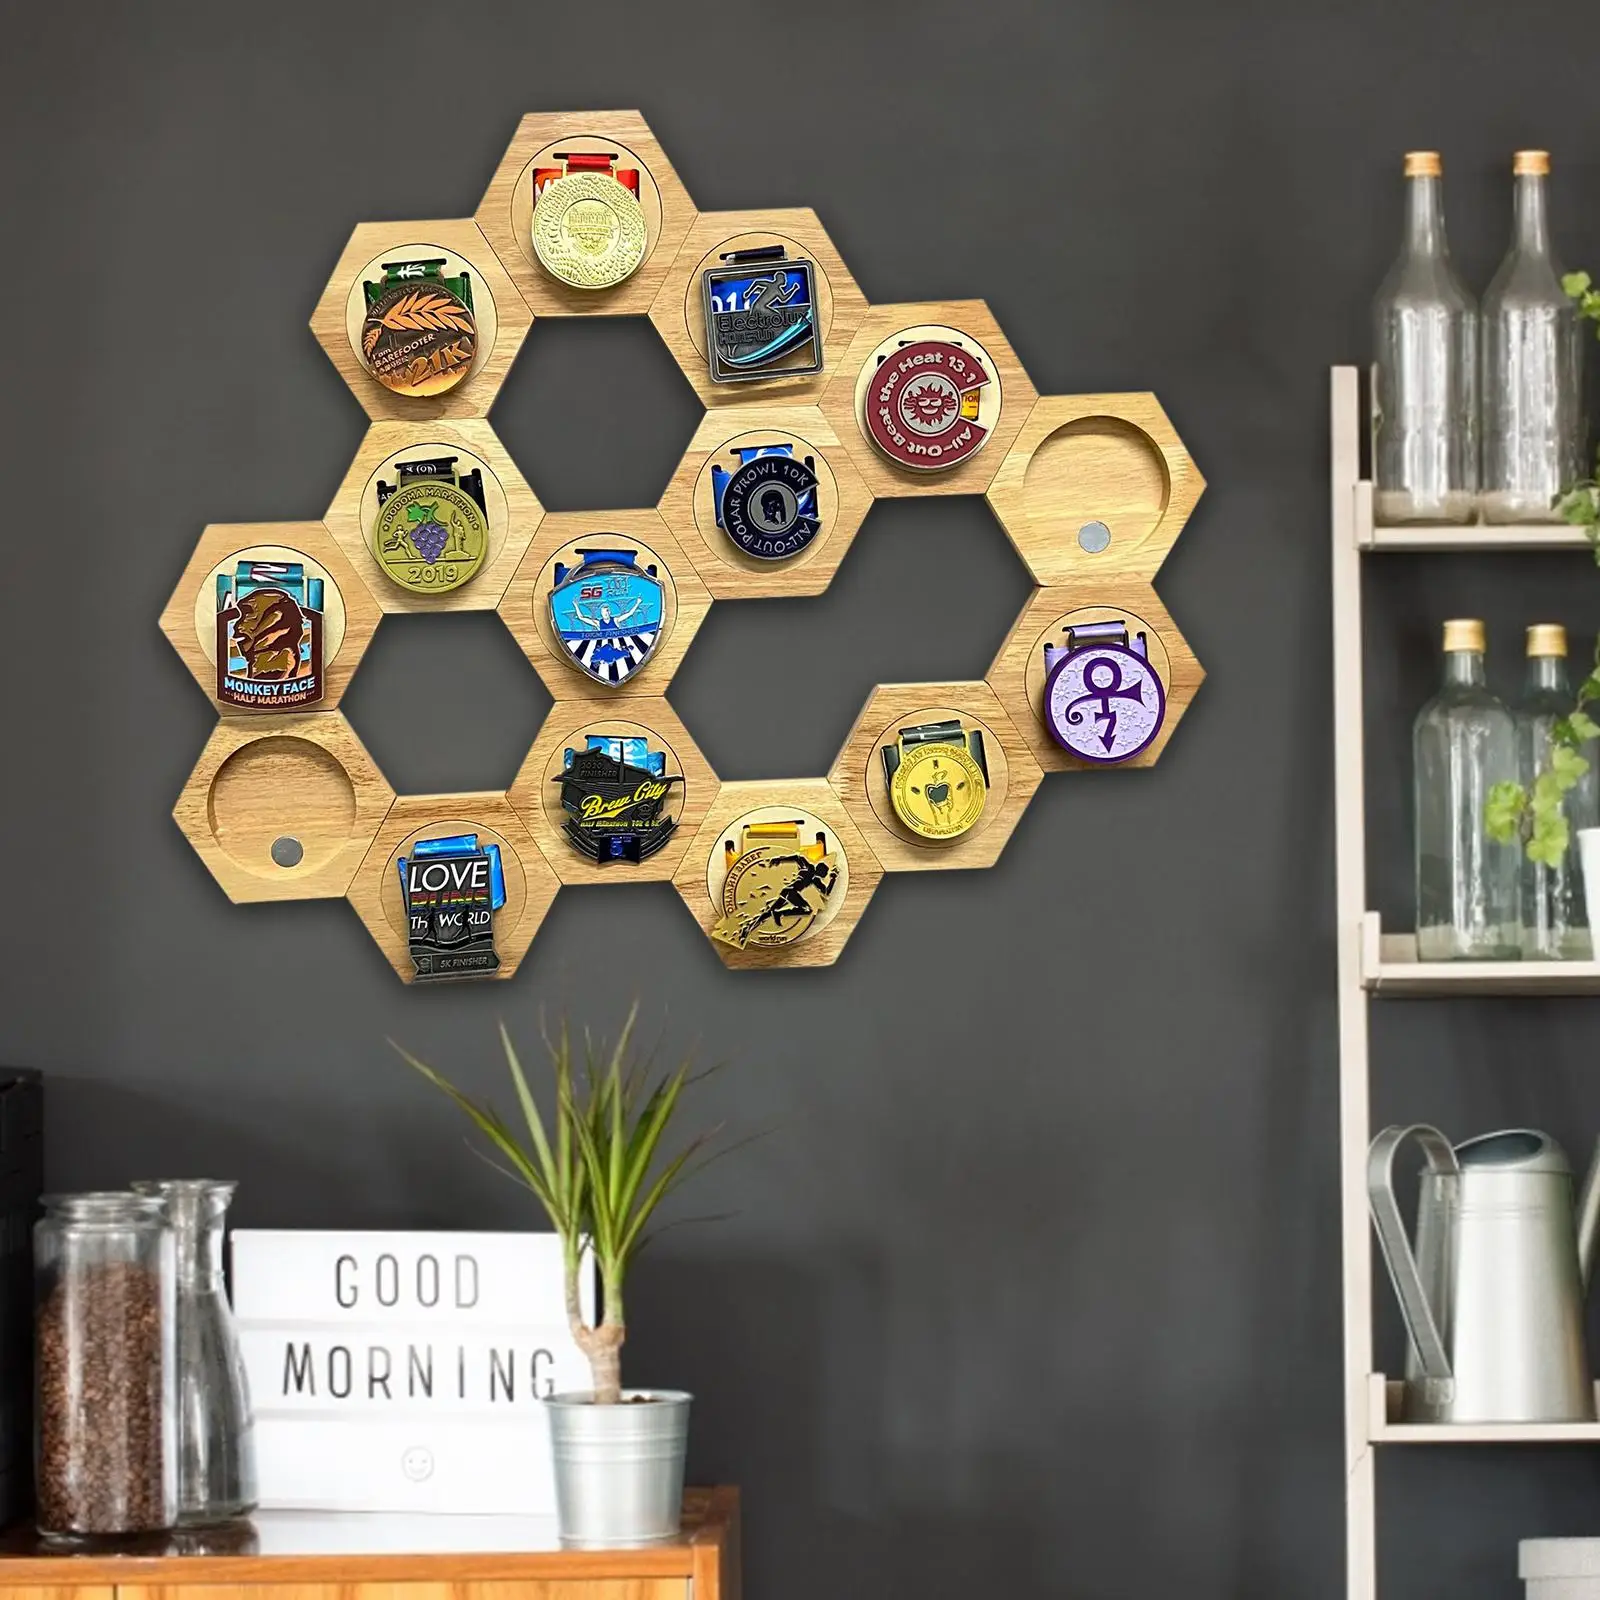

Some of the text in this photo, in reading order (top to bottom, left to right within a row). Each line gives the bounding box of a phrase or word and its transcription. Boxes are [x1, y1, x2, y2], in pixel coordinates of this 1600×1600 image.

[718, 310, 812, 332] Electrolux
[375, 333, 436, 368] BAREFOOTER
[408, 340, 471, 387] 21K
[879, 352, 976, 457] All-Out Beat the Heat 13.1
[386, 488, 475, 523] DODOMA MARATHON
[730, 462, 811, 553] ALL-OUT POLAR PROWL 10K
[408, 565, 459, 583] 2019
[580, 586, 603, 599] SG
[224, 676, 315, 695] MONKEY FACE
[233, 691, 307, 705] HALF MARATHON
[581, 795, 632, 819] Brew
[633, 781, 667, 802] City
[409, 861, 489, 893] LOVE
[440, 956, 488, 968] 5K FINISHER
[335, 1254, 479, 1309] GOOD
[283, 1342, 555, 1403] MORNING
